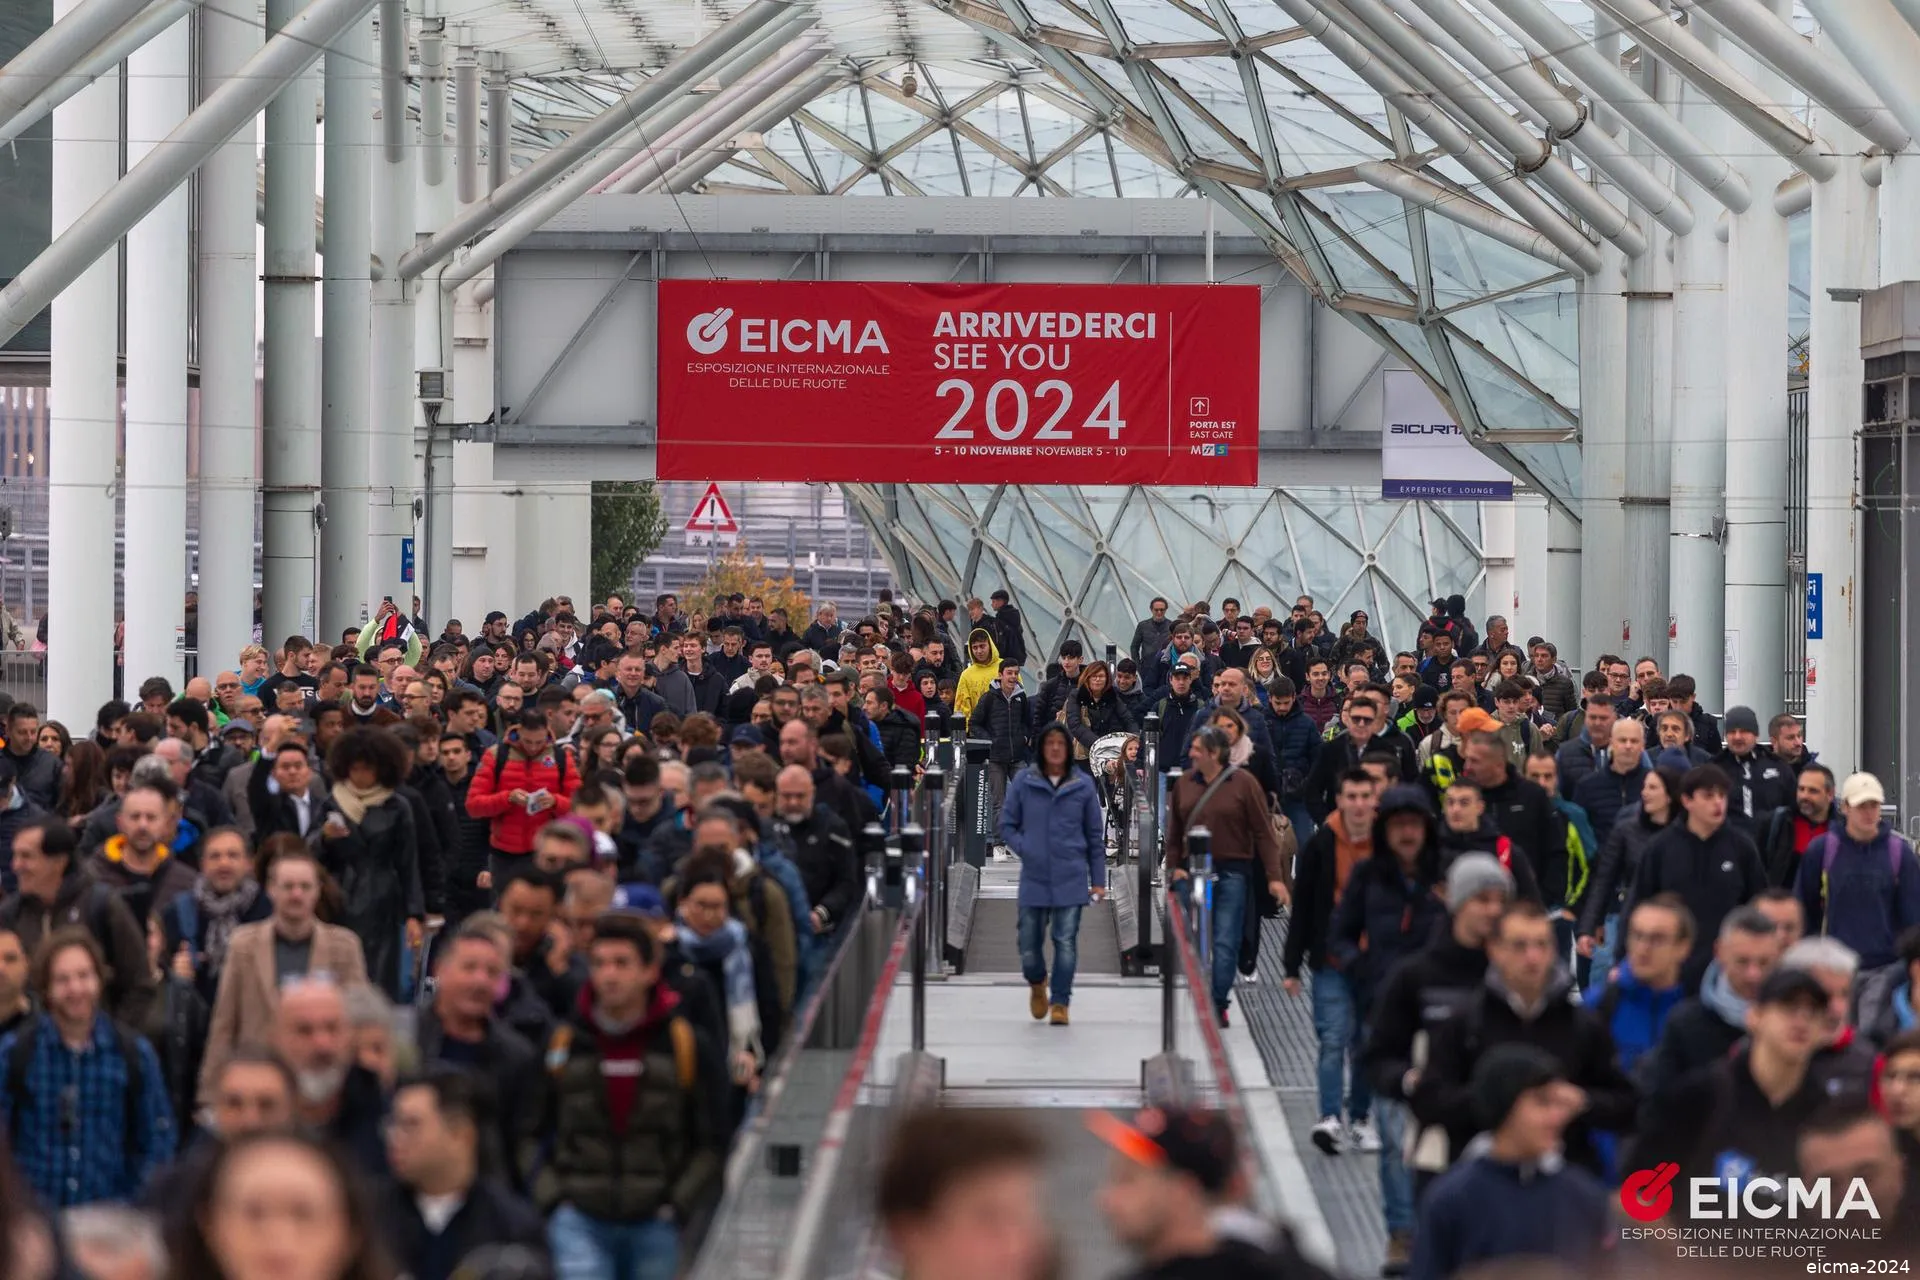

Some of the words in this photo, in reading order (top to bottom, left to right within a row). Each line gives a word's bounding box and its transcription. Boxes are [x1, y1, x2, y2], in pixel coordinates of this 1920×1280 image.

[933, 311, 1156, 339] ARRIVEDERCI
[740, 318, 890, 354] EICMA
[934, 343, 987, 370] SEE
[998, 343, 1070, 371] YOU
[687, 363, 774, 374] ESPOSIZIONE
[777, 364, 890, 375] INTERNAZIONALE
[729, 377, 771, 388] DELLE
[773, 378, 801, 389] DUE
[802, 378, 847, 389] RUOTE
[934, 378, 1127, 441] 2024
[1190, 421, 1219, 429] PORTA
[1221, 421, 1236, 429] EST
[1391, 424, 1462, 435] SICURIT
[1190, 430, 1210, 439] EAST
[1212, 430, 1233, 439] GATE
[935, 446, 942, 456] 5
[954, 446, 967, 456] 10
[970, 446, 1032, 456] NOVEMBRE
[1036, 446, 1093, 457] NOVEMBER
[1096, 447, 1103, 457] 5
[1114, 447, 1127, 457] 10
[1400, 486, 1452, 494] EXPERIENCE
[1459, 487, 1494, 495] LOUNGE
[976, 769, 985, 834] INDIFFERENZIATA
